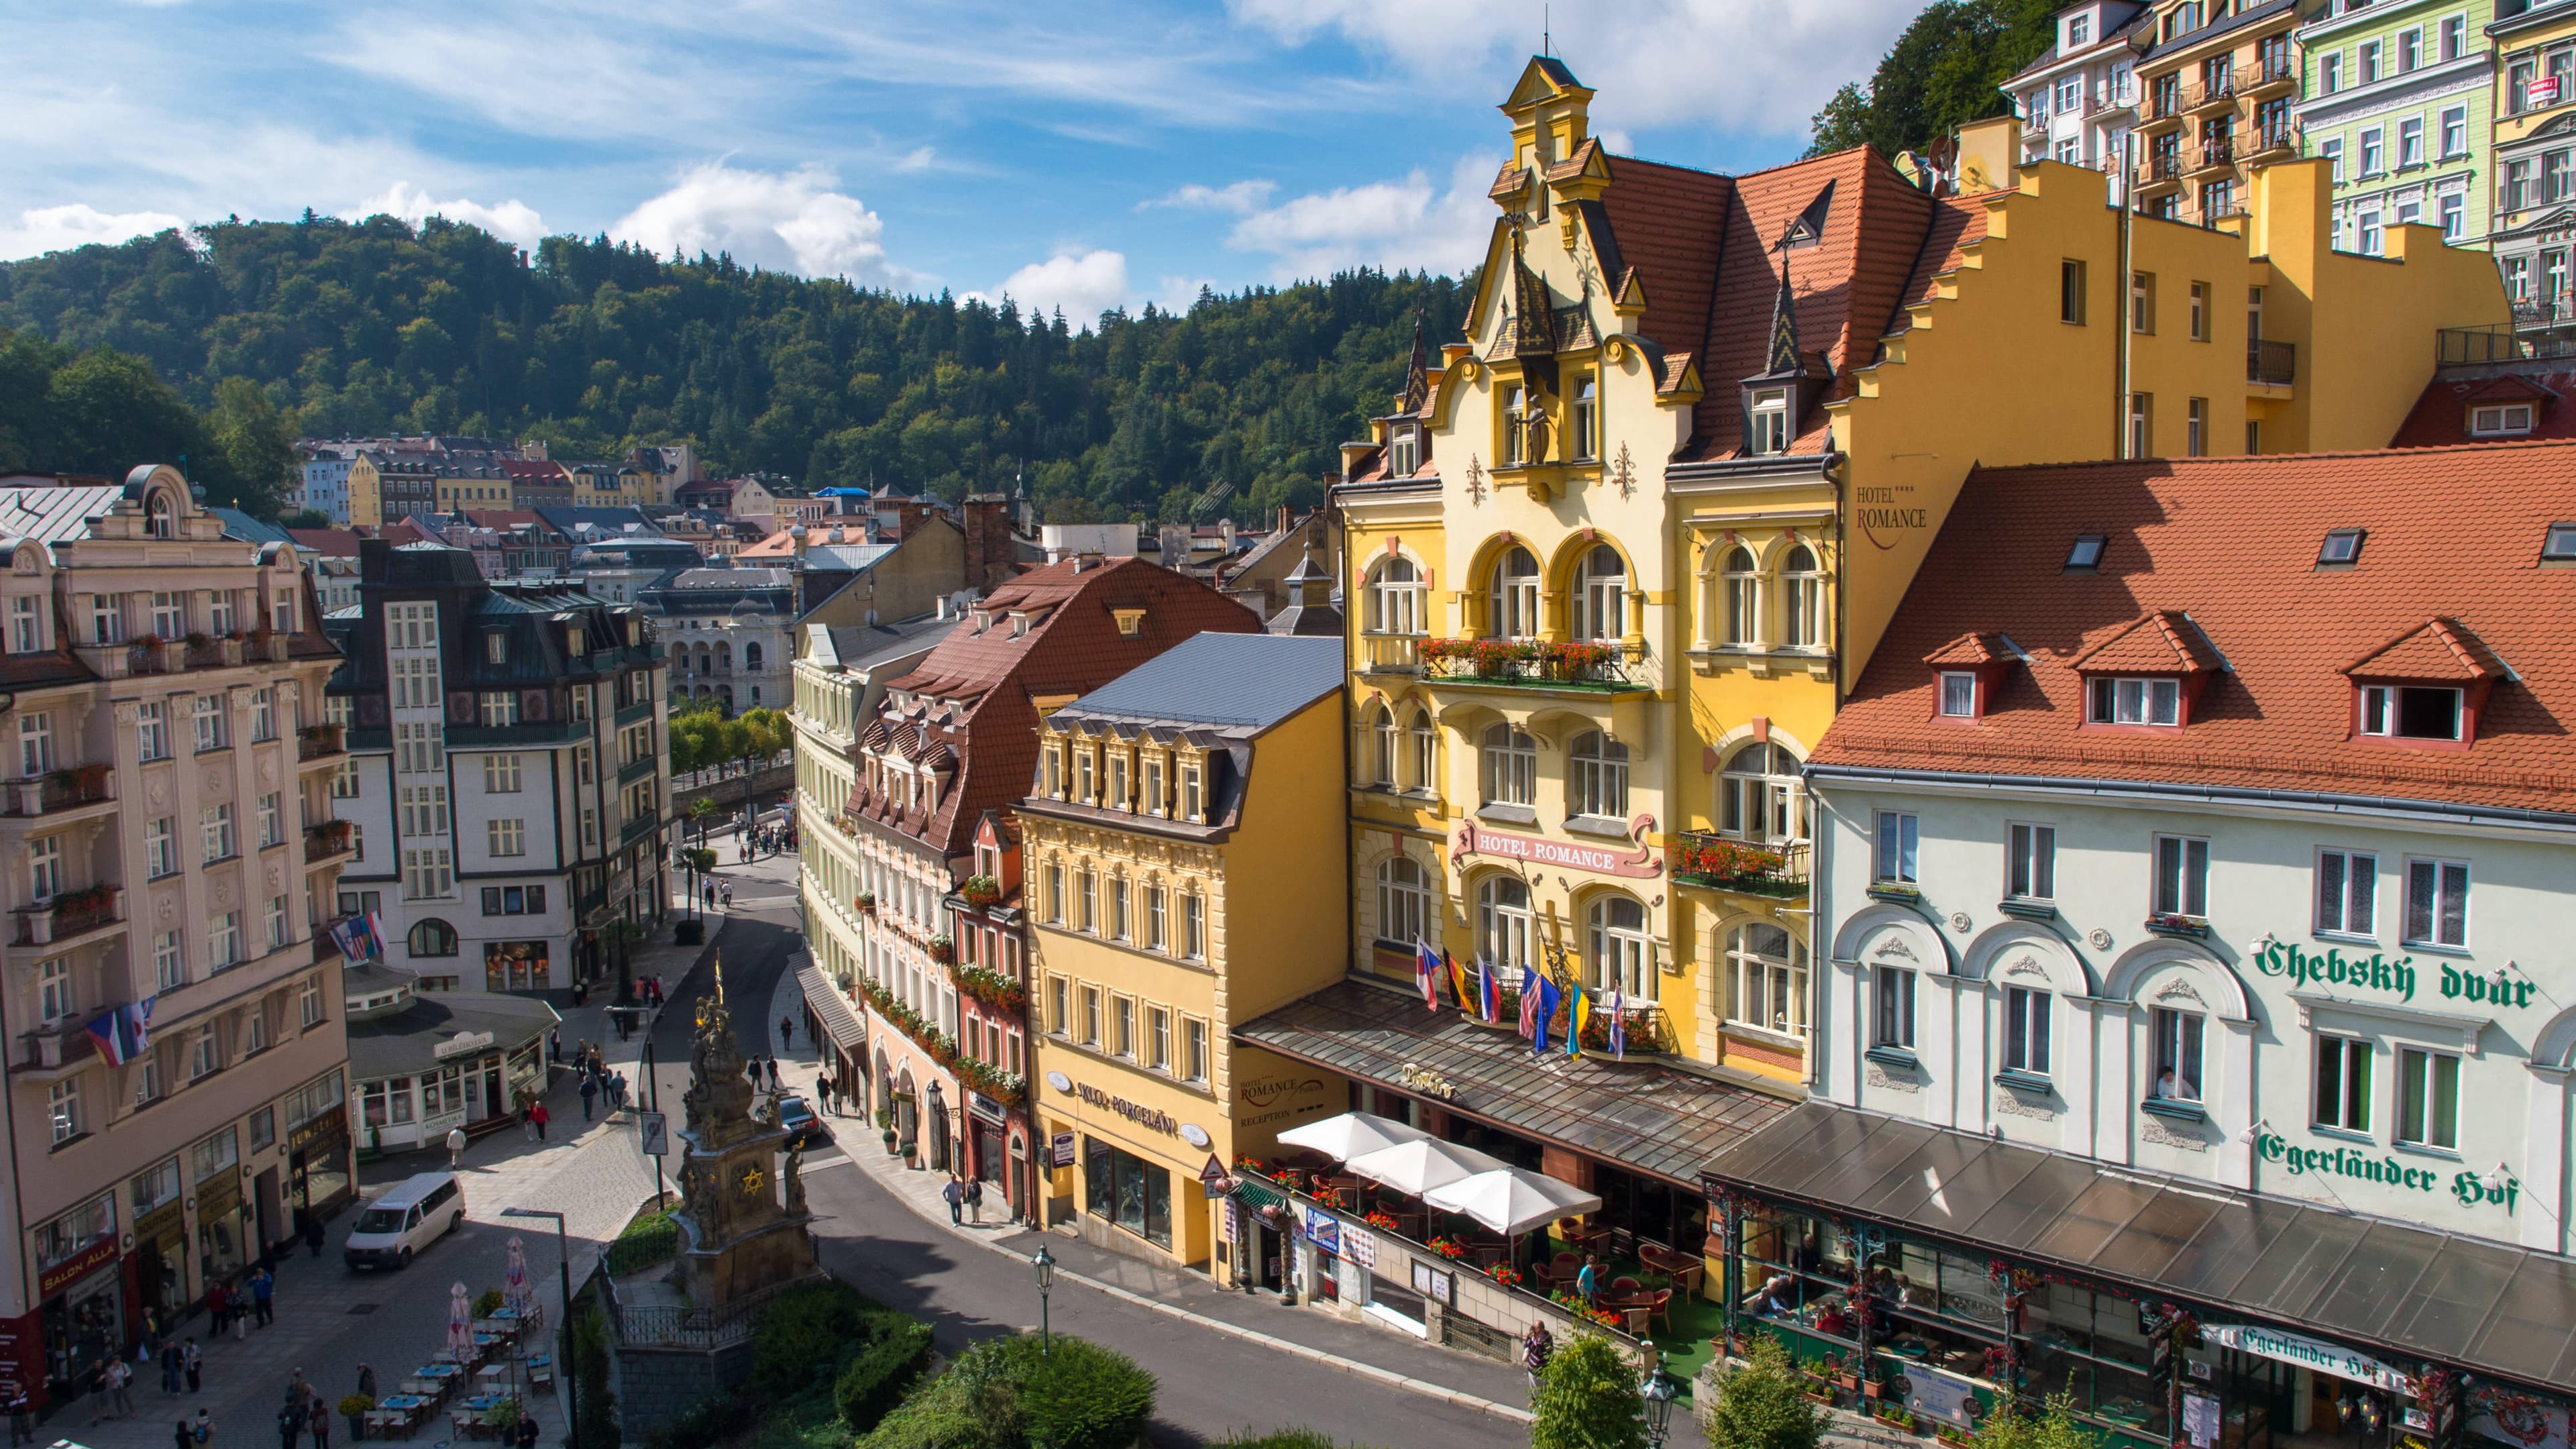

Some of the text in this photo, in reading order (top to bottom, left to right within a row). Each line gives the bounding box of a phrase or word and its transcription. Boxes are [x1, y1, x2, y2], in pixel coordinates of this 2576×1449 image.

[1857, 486, 1894, 503] HOTEL
[1857, 508, 1927, 529] ROMANCE
[1479, 834, 1615, 870] HOTEL ROMANCE
[2255, 940, 2415, 1004] Chebský
[1240, 1079, 1261, 1089] HOTEL
[1240, 1079, 1297, 1101] ROMANCE
[425, 1114, 463, 1130] KOSMETIKA
[1077, 1082, 1174, 1134] SKLO PORCELÁN
[1241, 1109, 1290, 1128] RECEPTION
[2258, 1134, 2518, 1218] Egerländer Hof
[137, 1205, 178, 1235] BOUTIQUE
[44, 1263, 83, 1291] SALON
[87, 1244, 115, 1267] ALLA
[2241, 1327, 2337, 1368] Egerländer
